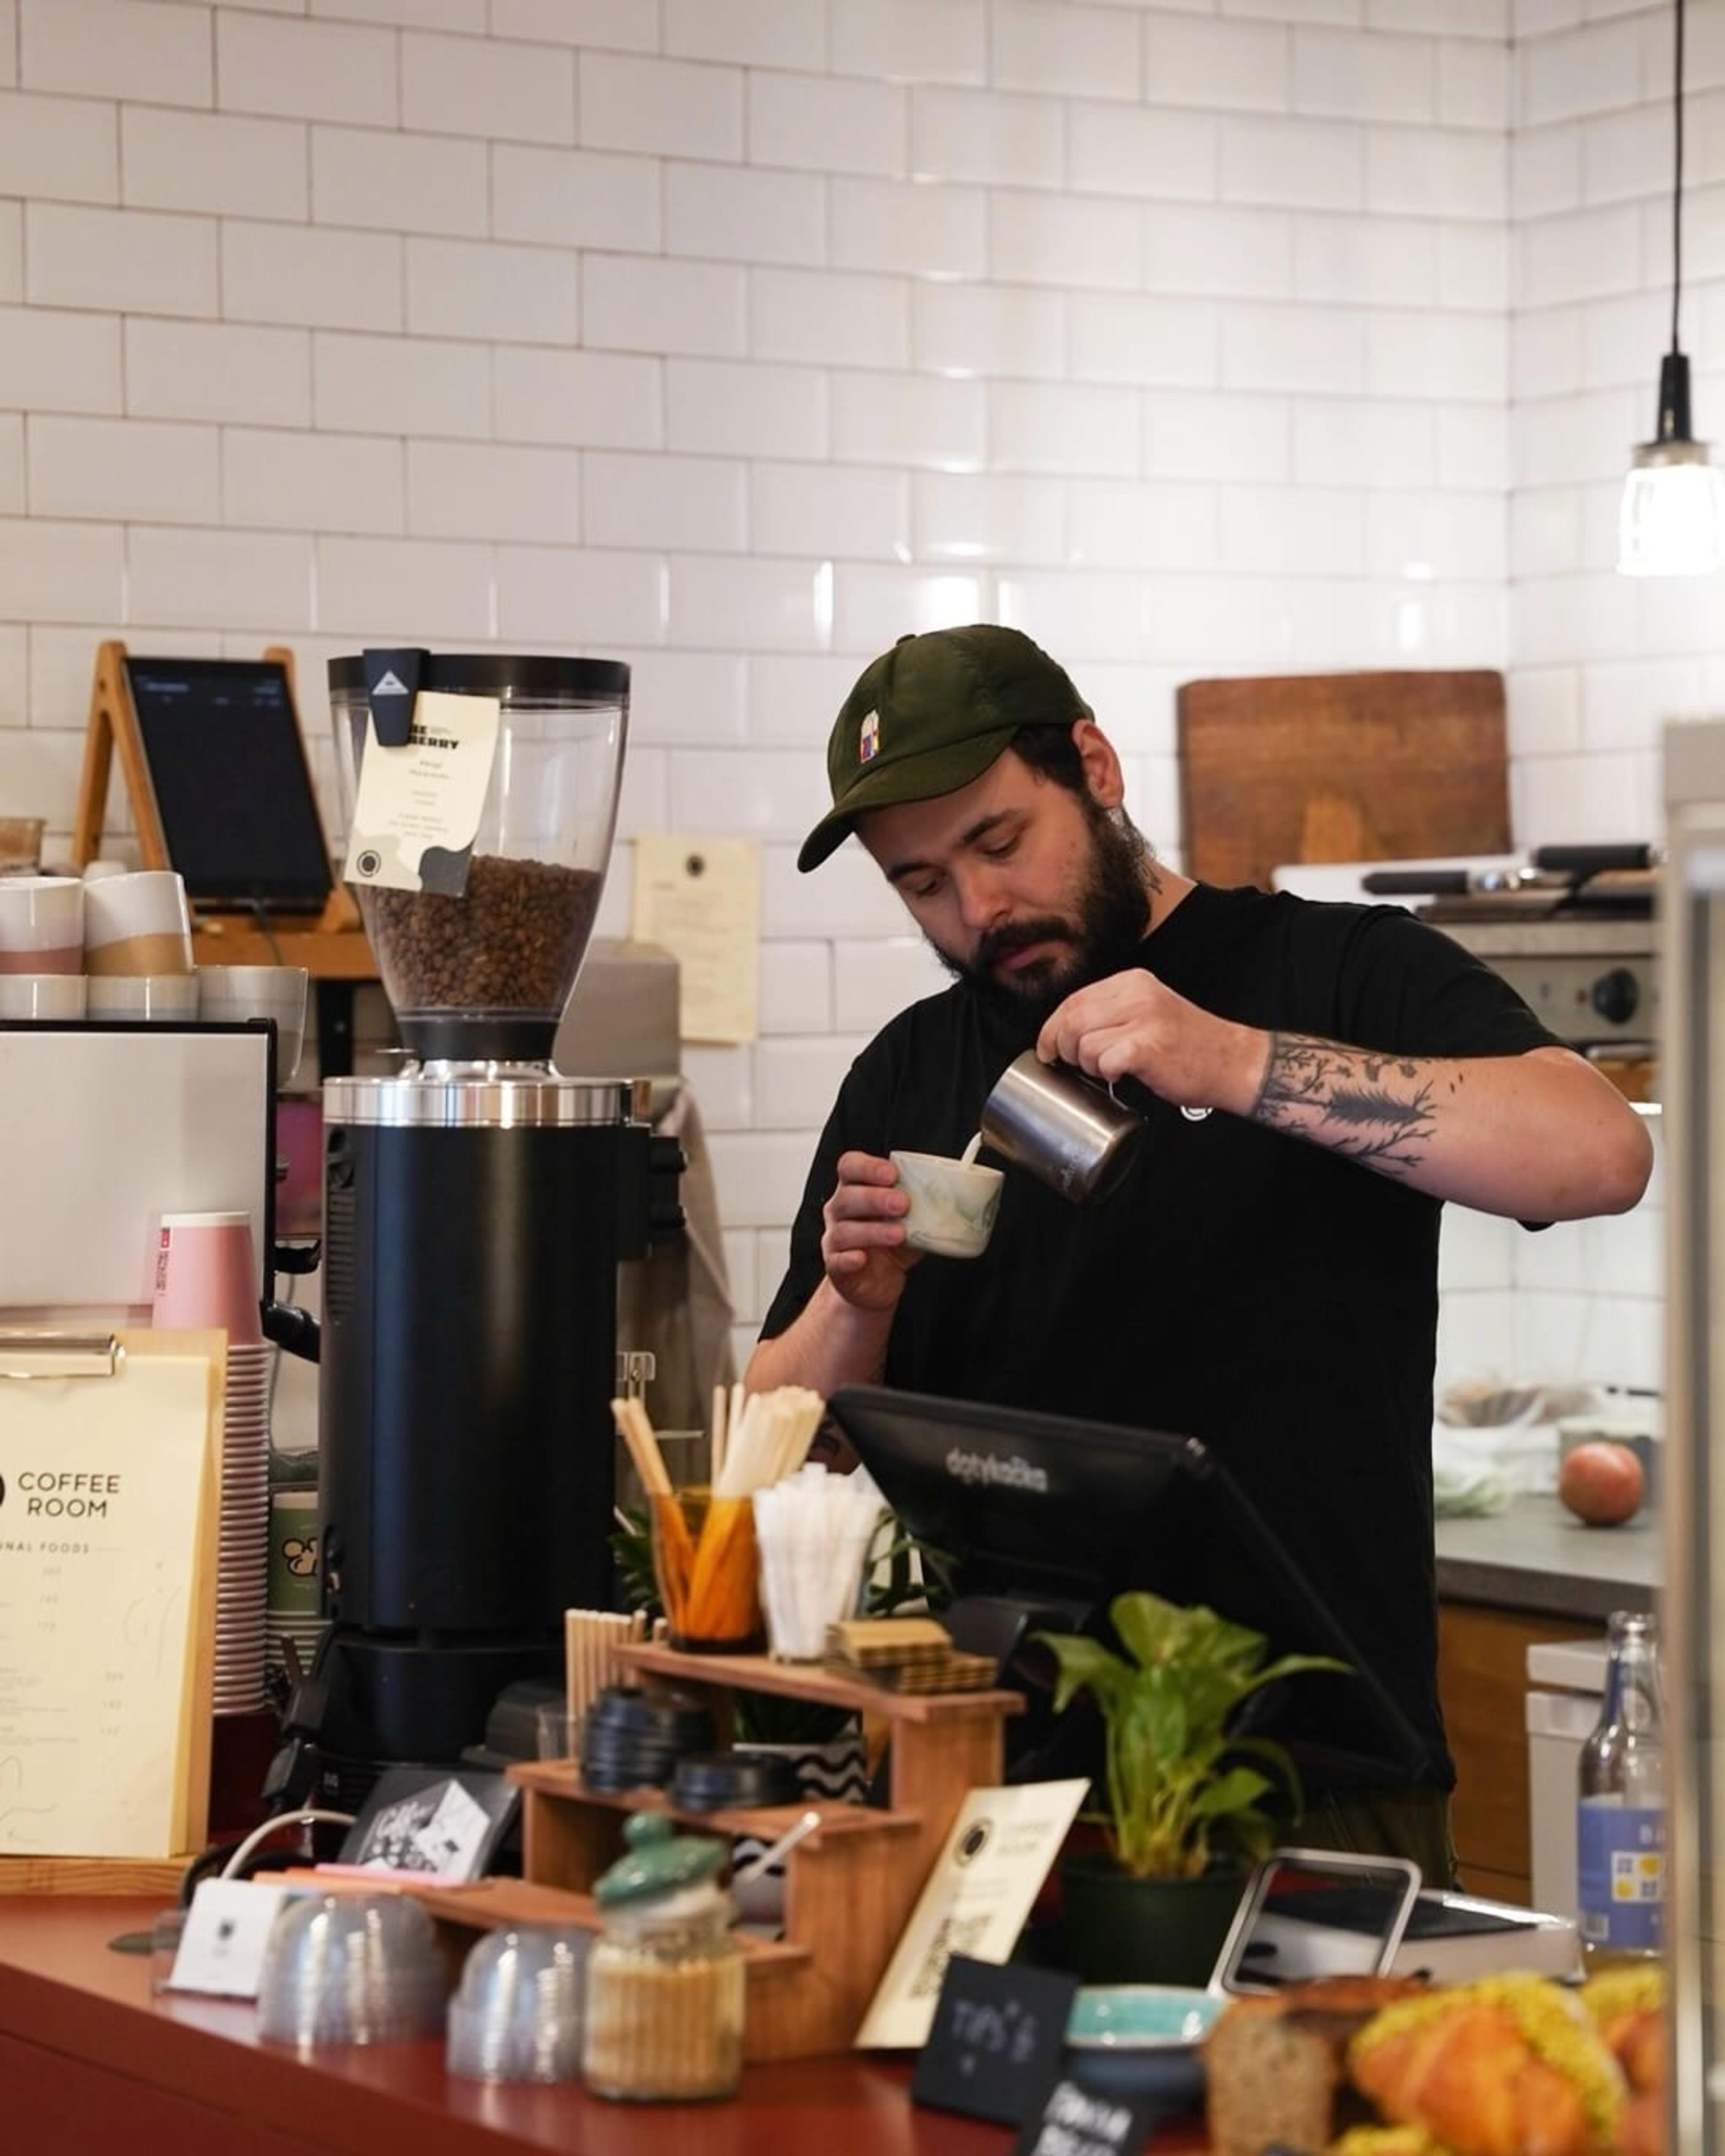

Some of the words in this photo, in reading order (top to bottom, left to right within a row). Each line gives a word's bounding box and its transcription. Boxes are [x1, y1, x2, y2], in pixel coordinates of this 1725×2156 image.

[18, 1471, 121, 1493] COFFEE
[27, 1497, 107, 1518] ROOM
[0, 1541, 32, 1552] NAL
[40, 1542, 90, 1554] FOODS
